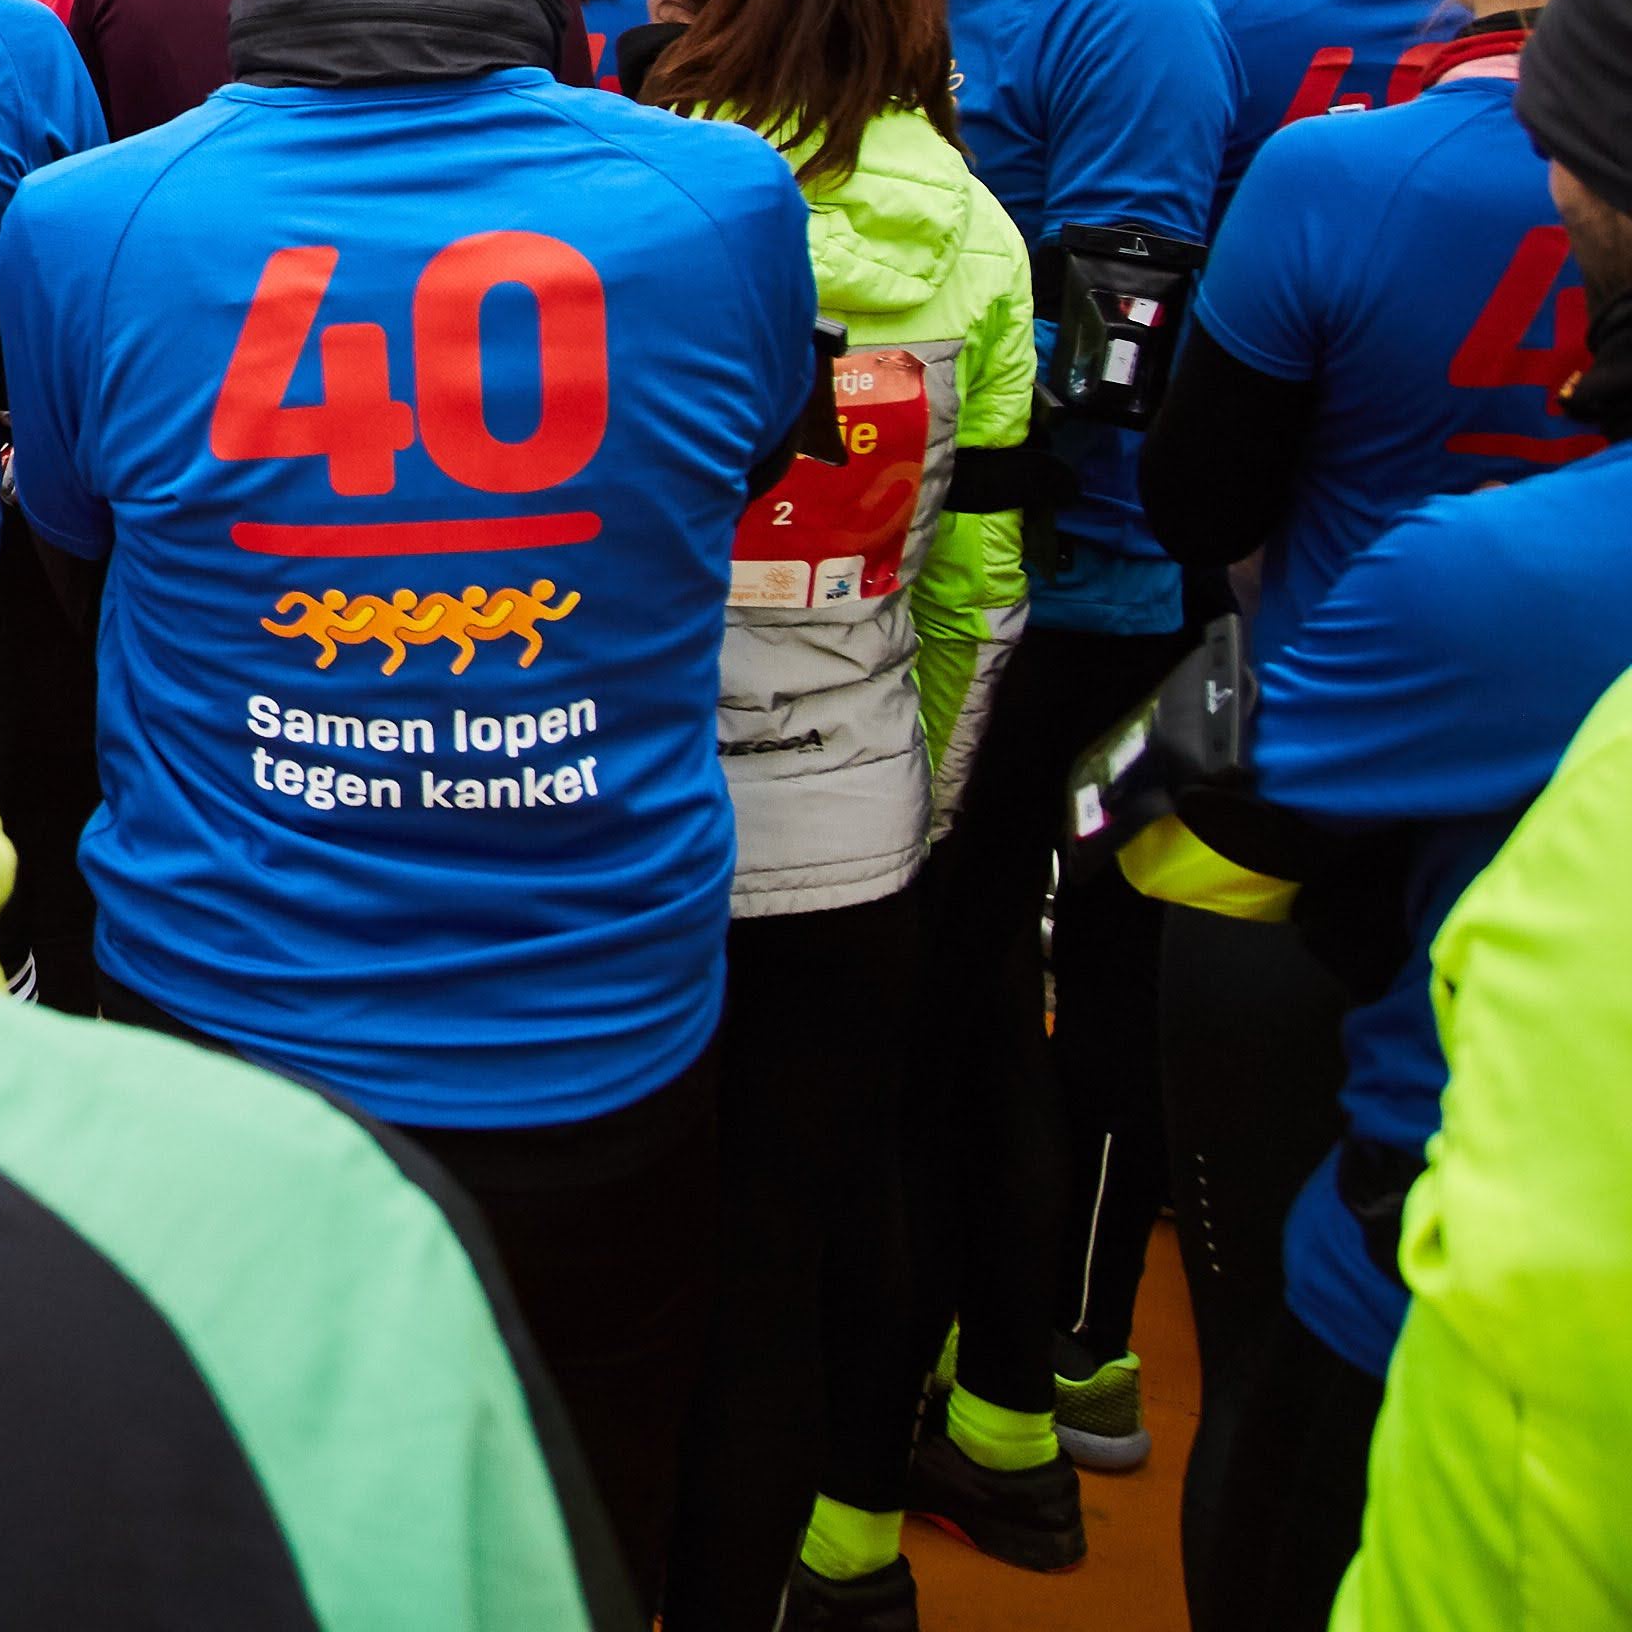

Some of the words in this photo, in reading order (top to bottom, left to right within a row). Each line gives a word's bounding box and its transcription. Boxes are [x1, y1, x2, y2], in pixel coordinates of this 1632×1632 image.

[209, 230, 610, 497] 40
[246, 694, 436, 755] Samen
[453, 695, 598, 758] lopen
[252, 746, 403, 813] tegen
[423, 752, 602, 811] kanker
